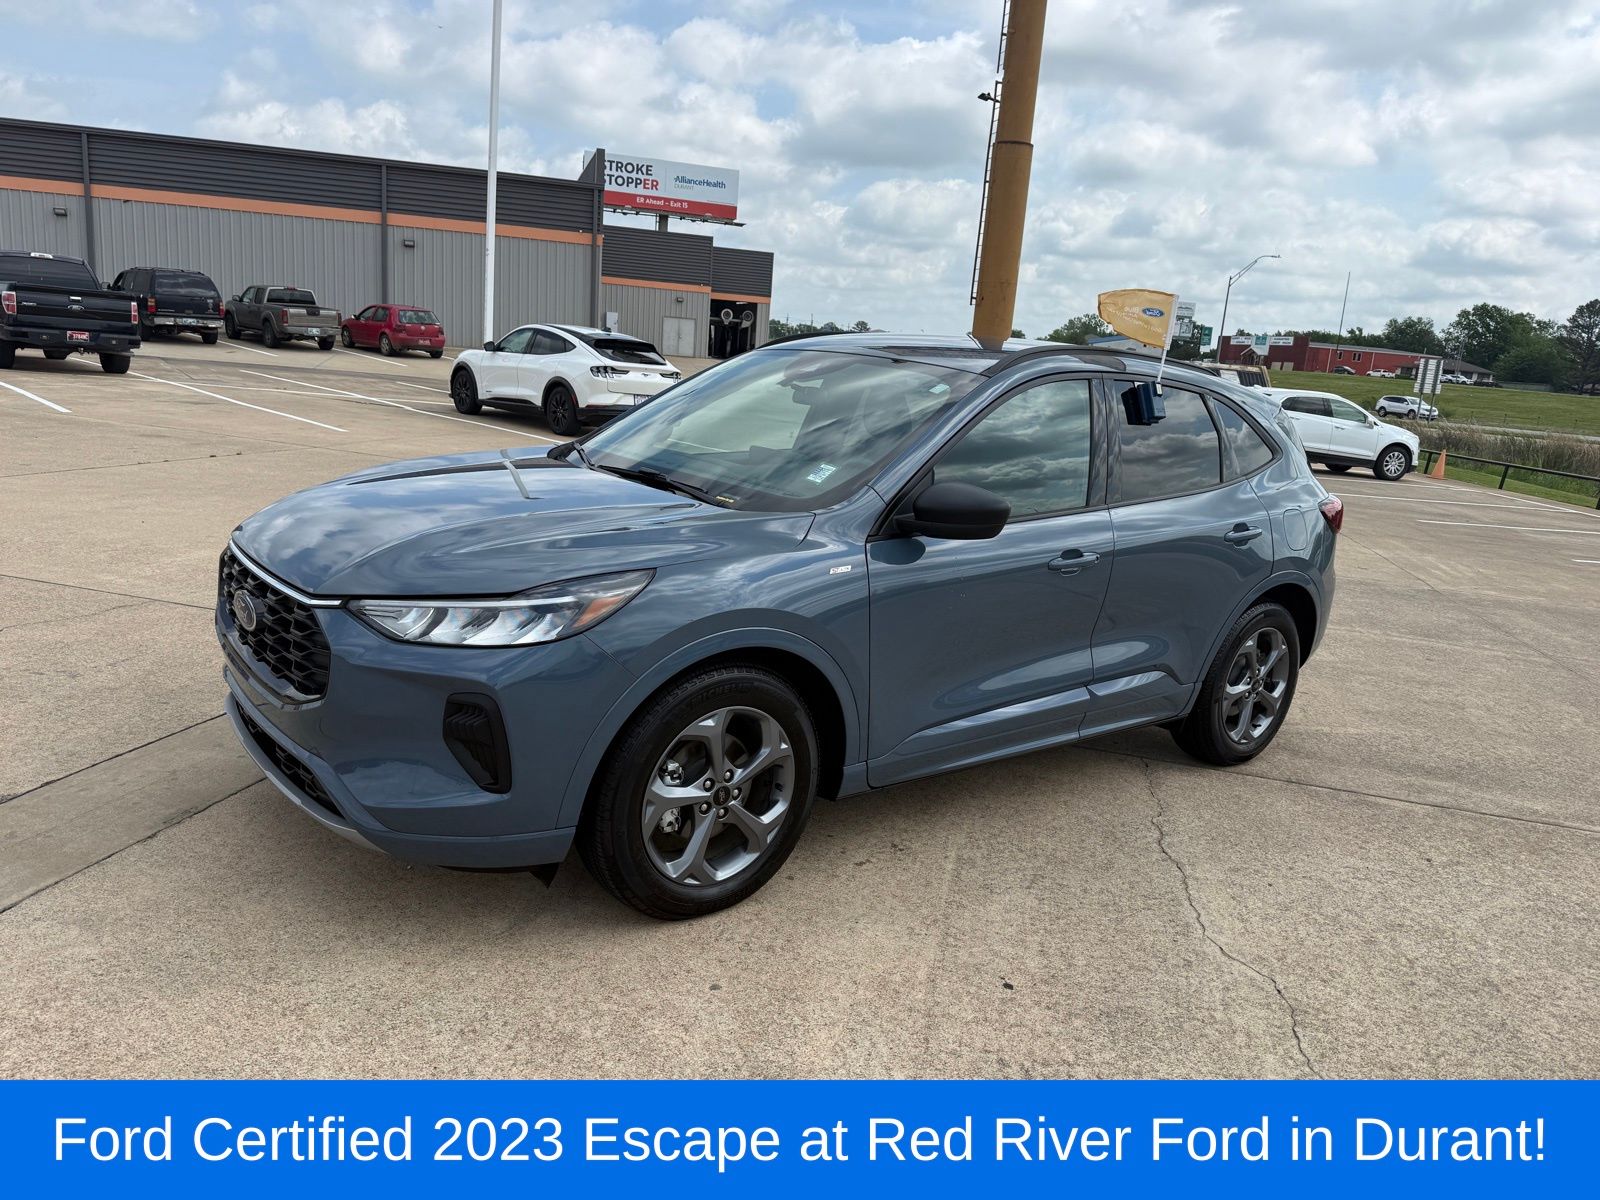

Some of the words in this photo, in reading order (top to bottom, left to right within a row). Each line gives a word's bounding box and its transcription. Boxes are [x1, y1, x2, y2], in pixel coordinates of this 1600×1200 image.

[604, 159, 653, 176] TROKE
[604, 173, 659, 191] TOPPER
[674, 175, 726, 189] AllianceHealth
[636, 196, 645, 204] ER
[645, 198, 664, 206] Ahead
